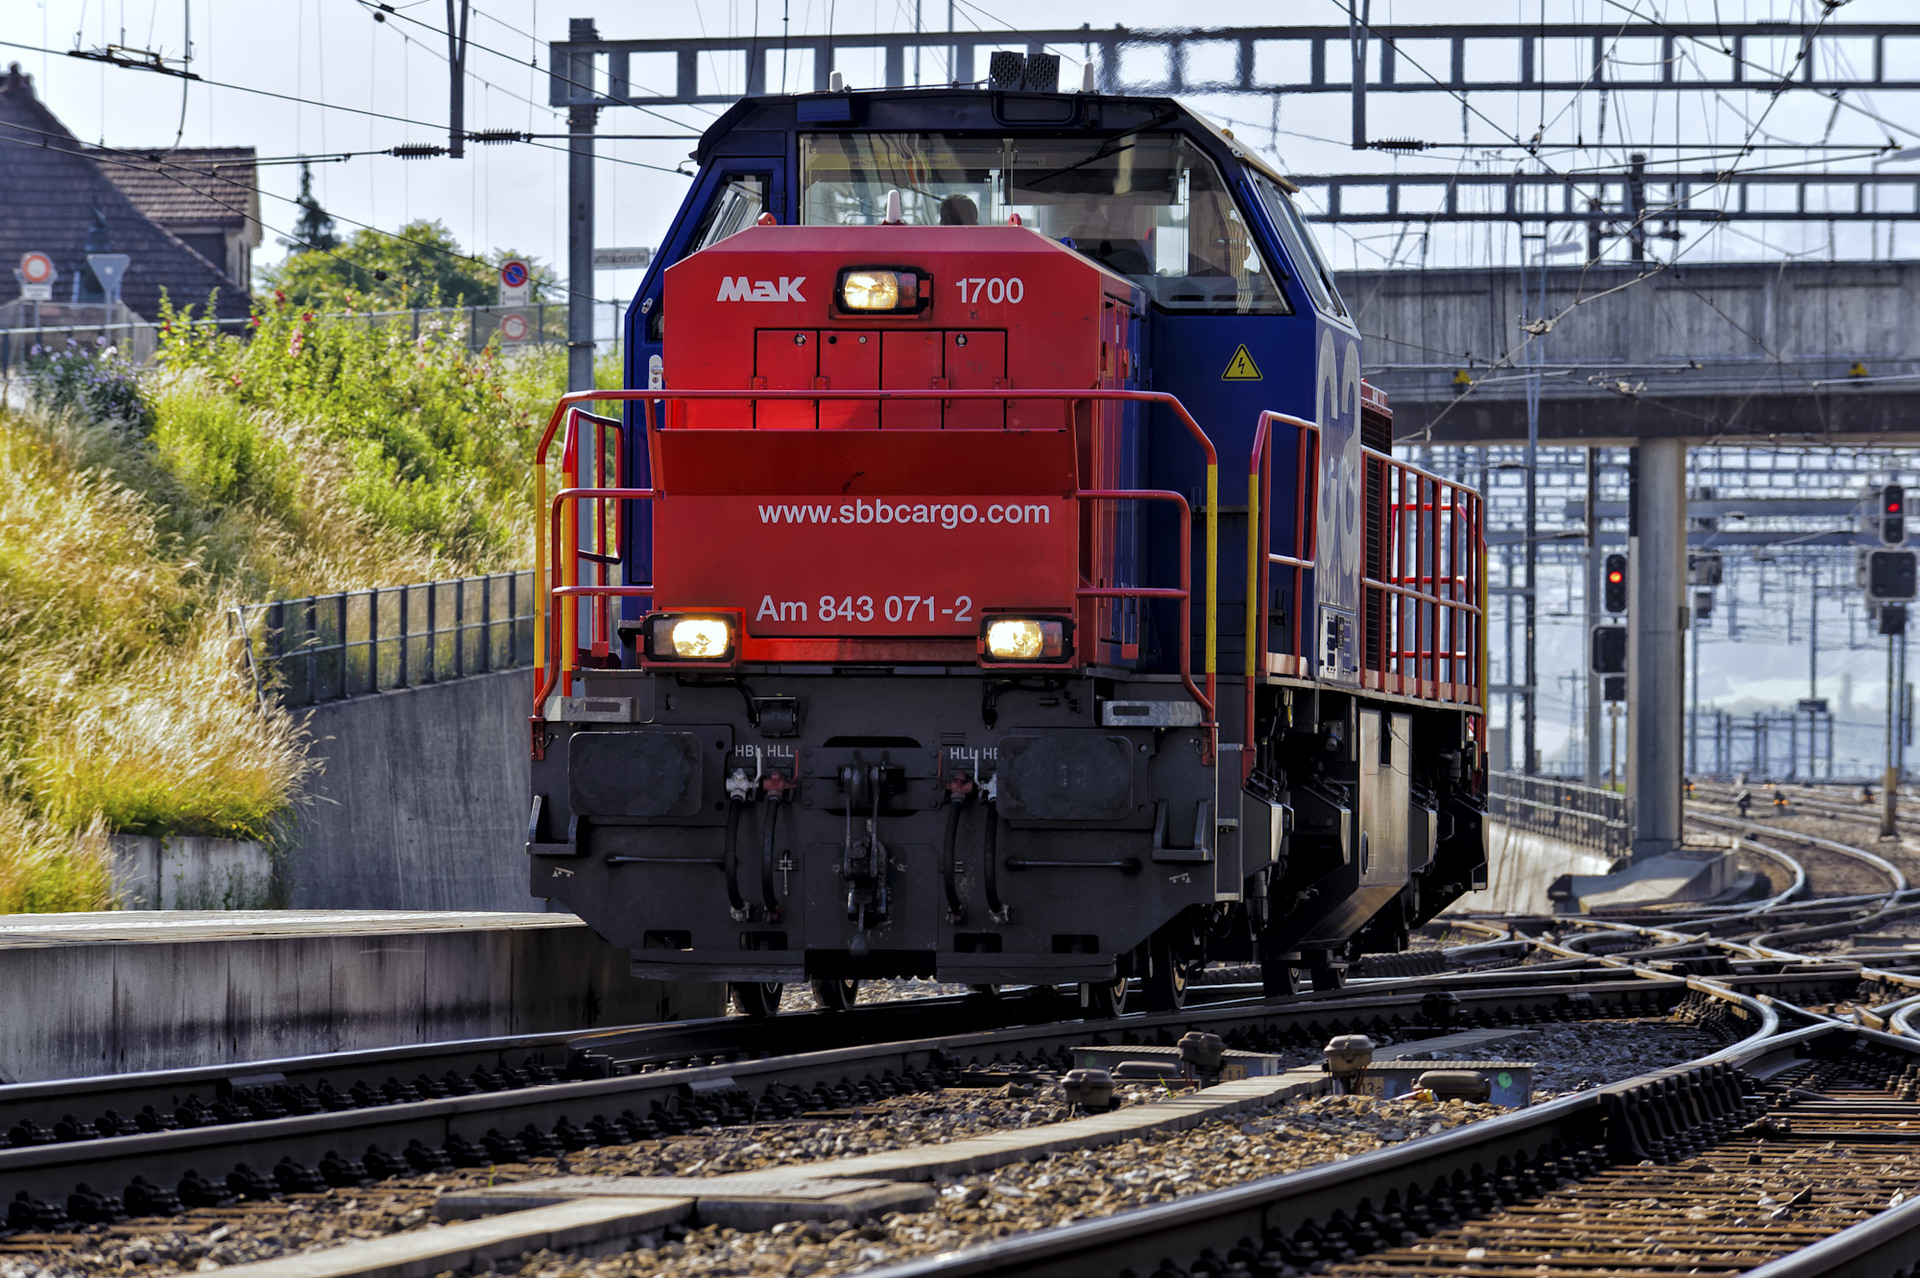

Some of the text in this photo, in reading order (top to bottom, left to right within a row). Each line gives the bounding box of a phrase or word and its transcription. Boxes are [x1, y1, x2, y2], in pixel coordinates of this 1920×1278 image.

[717, 276, 807, 302] MaK
[955, 278, 1024, 304] 1700
[758, 498, 1050, 530] www.sbbcargo.com
[755, 595, 972, 622] Am 843 071-2
[767, 744, 794, 757] HLL
[950, 747, 976, 760] HLL
